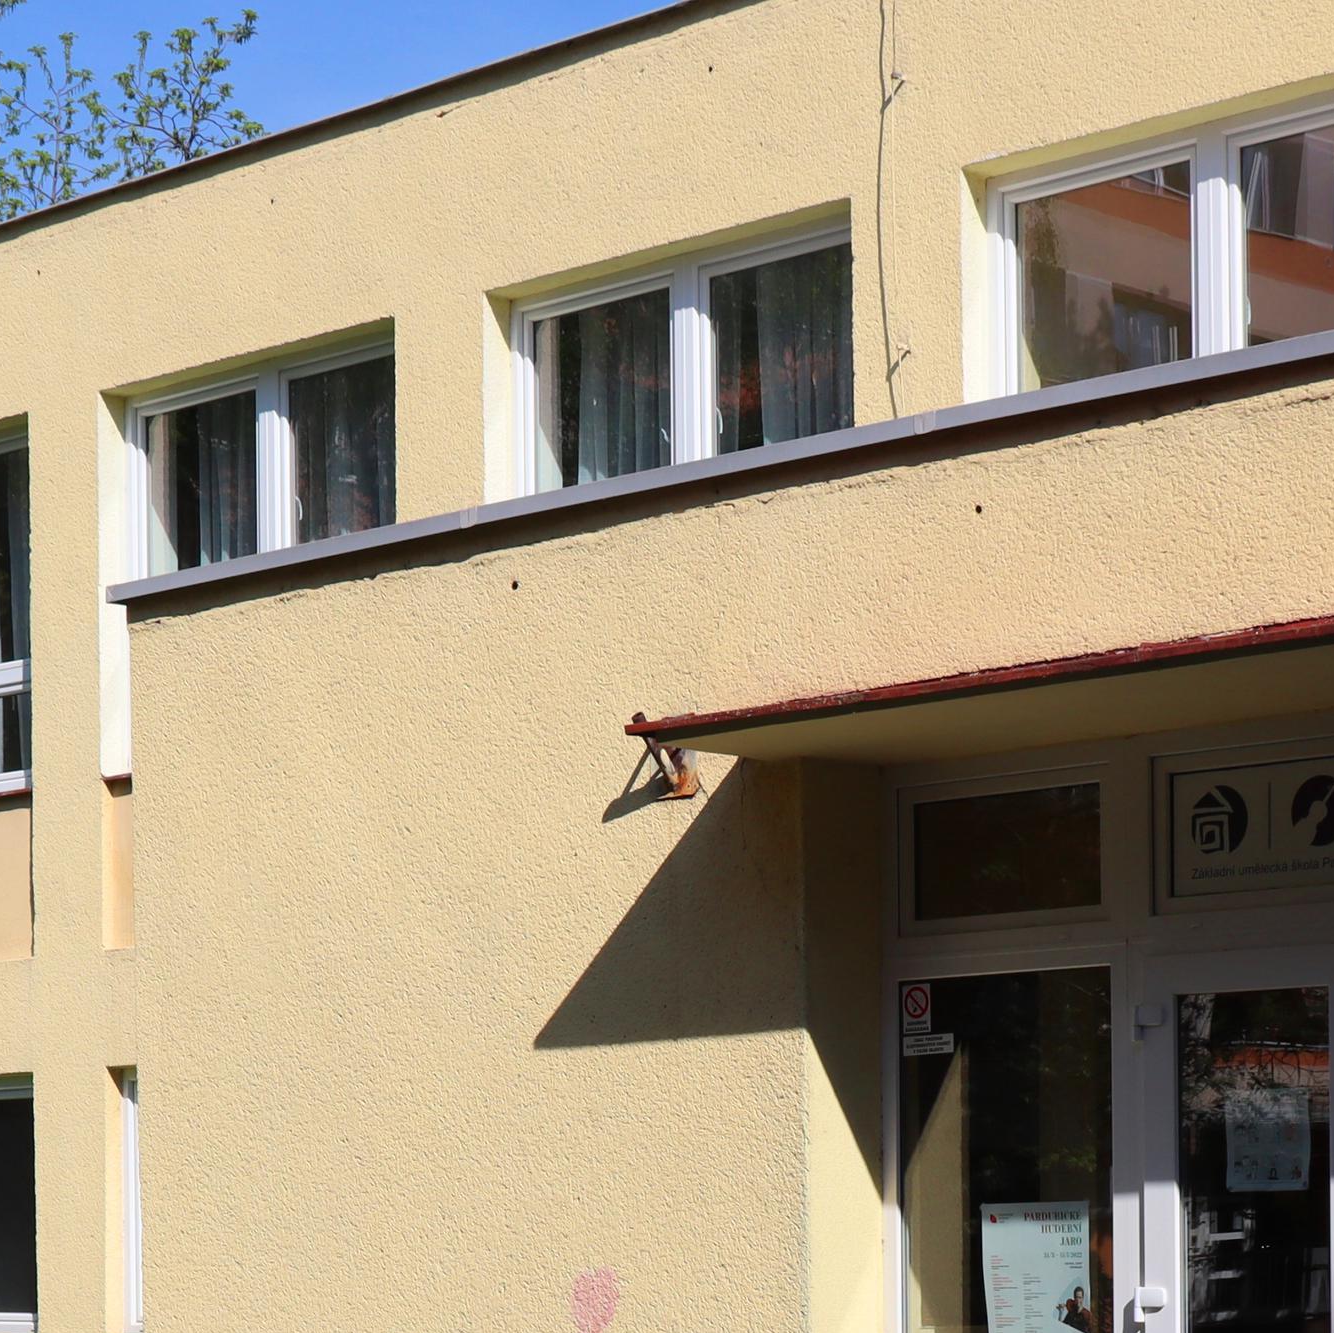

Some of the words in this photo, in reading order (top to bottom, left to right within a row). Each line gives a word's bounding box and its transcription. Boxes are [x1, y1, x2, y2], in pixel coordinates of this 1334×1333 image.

[1192, 865, 1236, 880] Základní
[1238, 862, 1288, 876] umělecká
[1291, 858, 1319, 872] škola
[1024, 1210, 1082, 1222] PARDUBICKÉ
[1041, 1222, 1082, 1233] HUDEBNÍ
[1060, 1236, 1082, 1246] JARO
